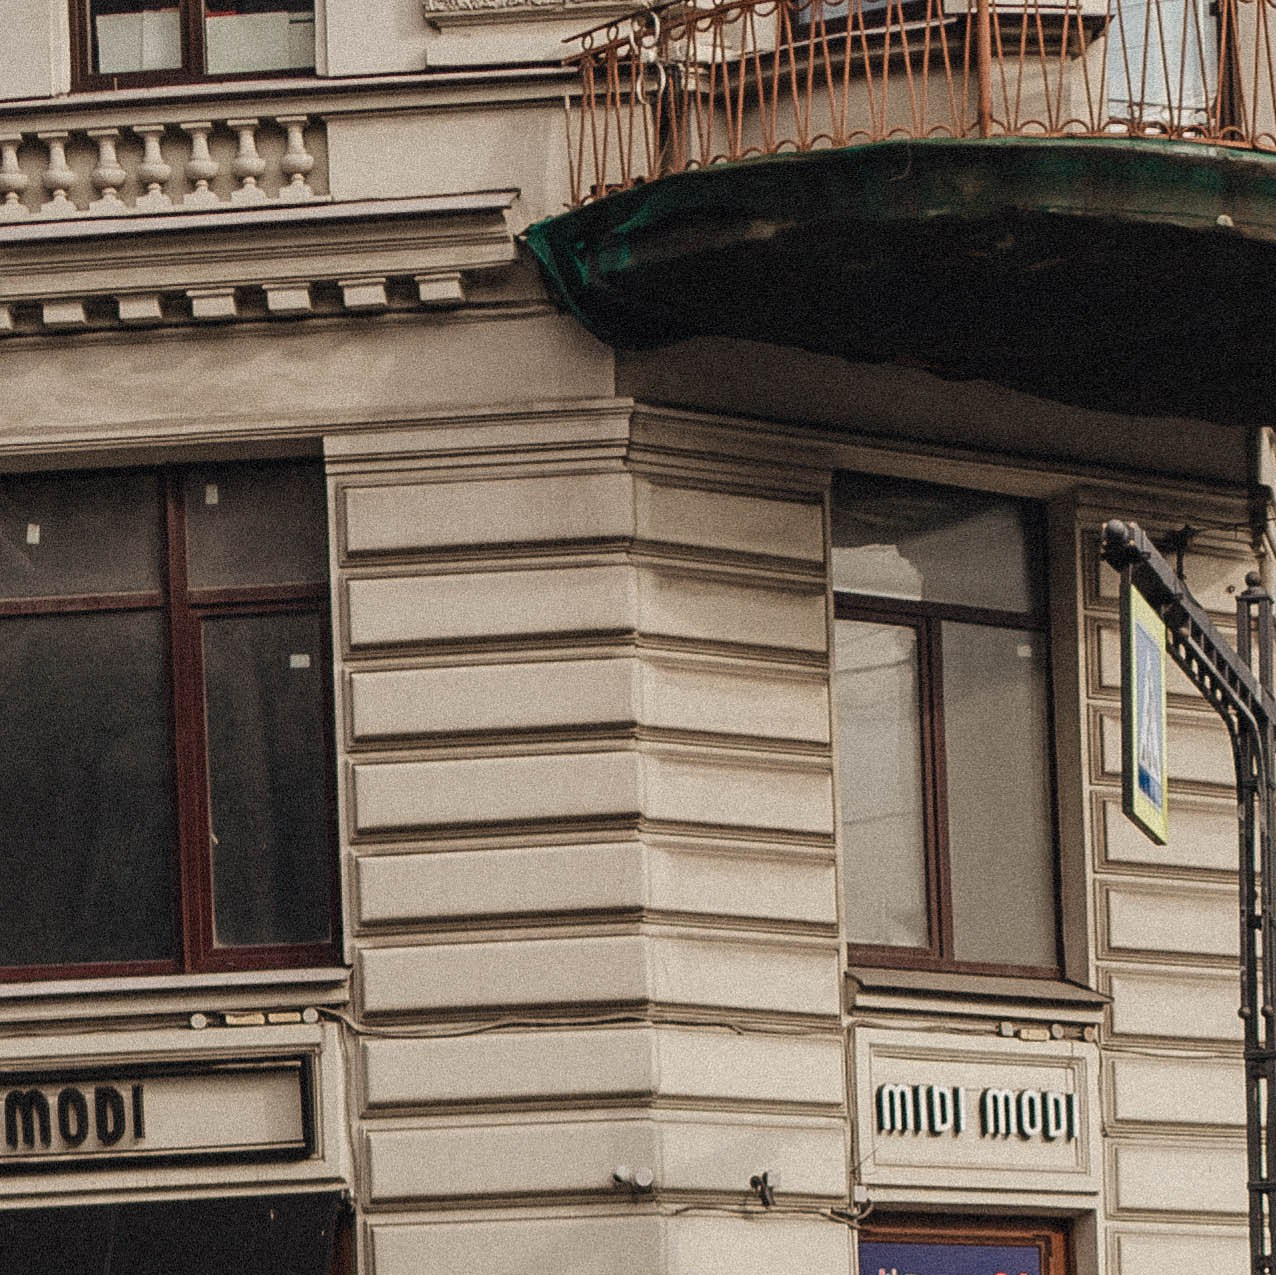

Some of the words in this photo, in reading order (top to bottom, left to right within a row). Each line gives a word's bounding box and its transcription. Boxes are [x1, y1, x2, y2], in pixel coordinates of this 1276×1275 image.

[5, 1084, 146, 1149] MODI
[876, 1083, 967, 1136] MIDI
[980, 1087, 1080, 1142] MODI
